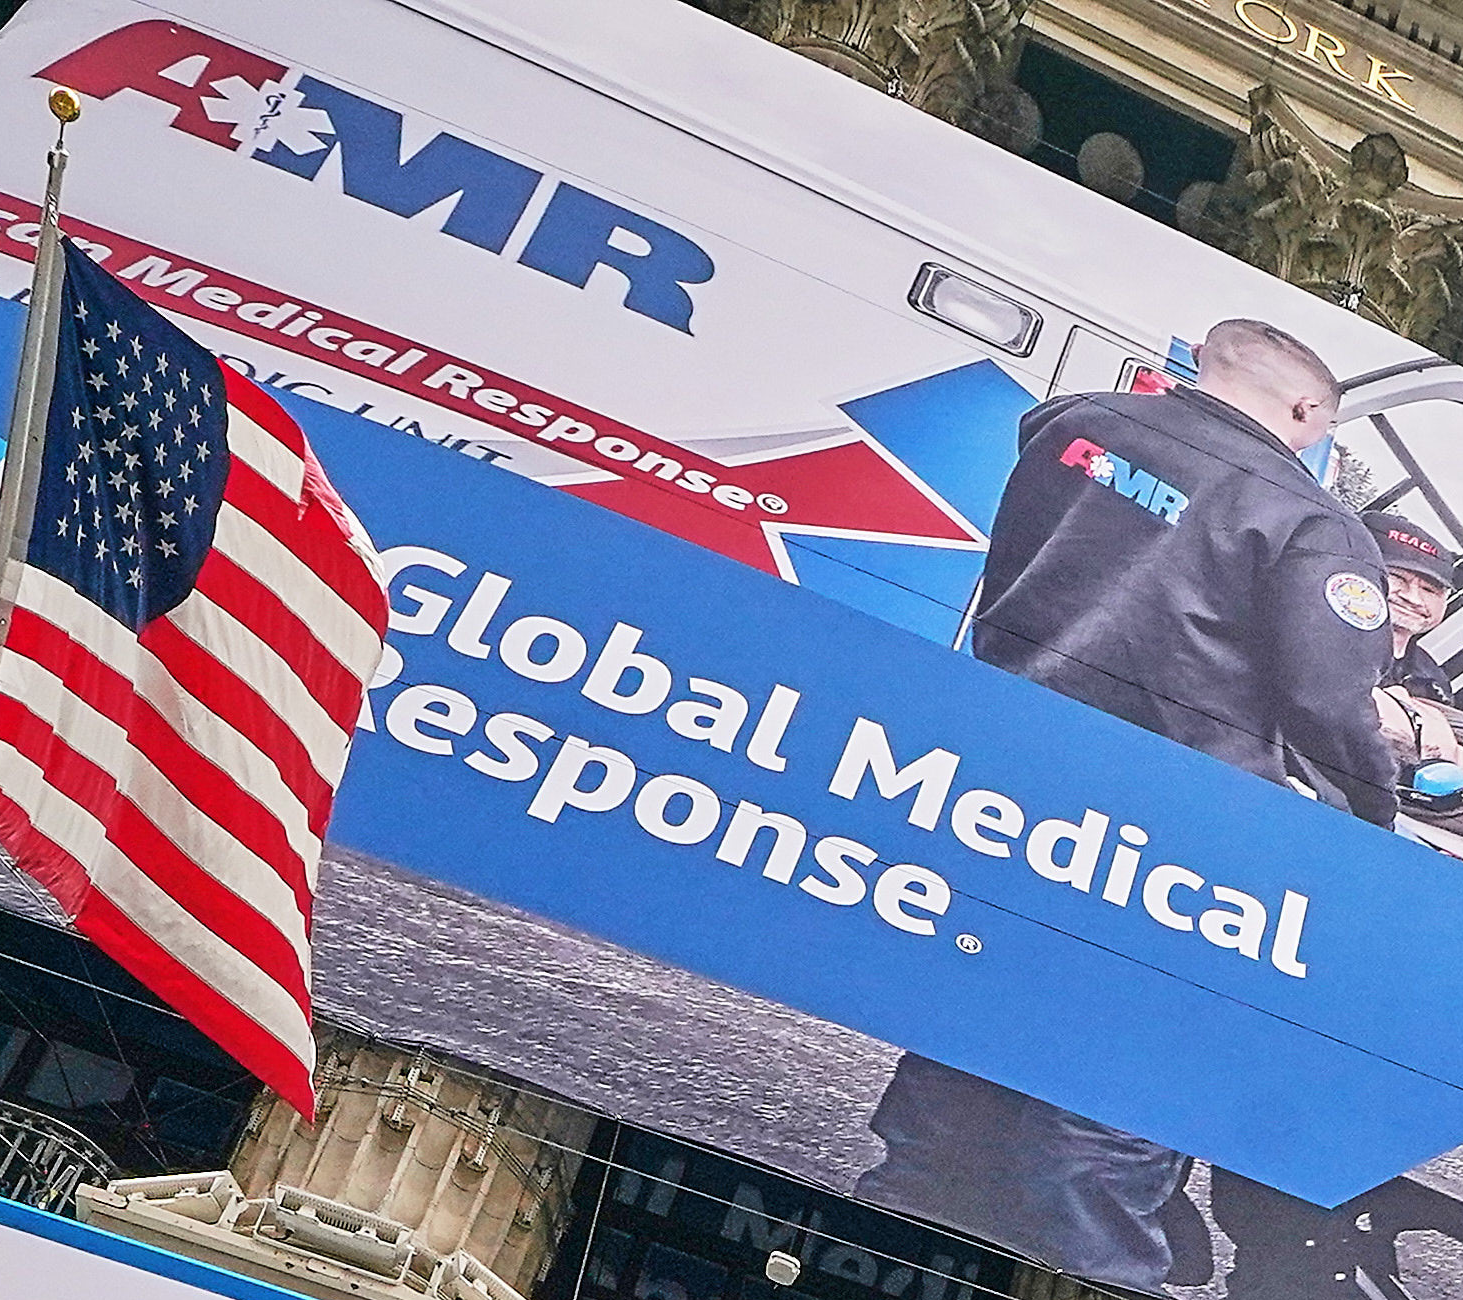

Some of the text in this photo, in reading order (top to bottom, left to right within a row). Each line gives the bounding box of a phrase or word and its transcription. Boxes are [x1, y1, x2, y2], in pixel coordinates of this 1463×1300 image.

[1199, 0, 1416, 112] ORK
[32, 19, 716, 337] AMR
[116, 254, 429, 376] Medical
[1059, 437, 1190, 527] AMR
[377, 545, 1308, 979] Global Medical
